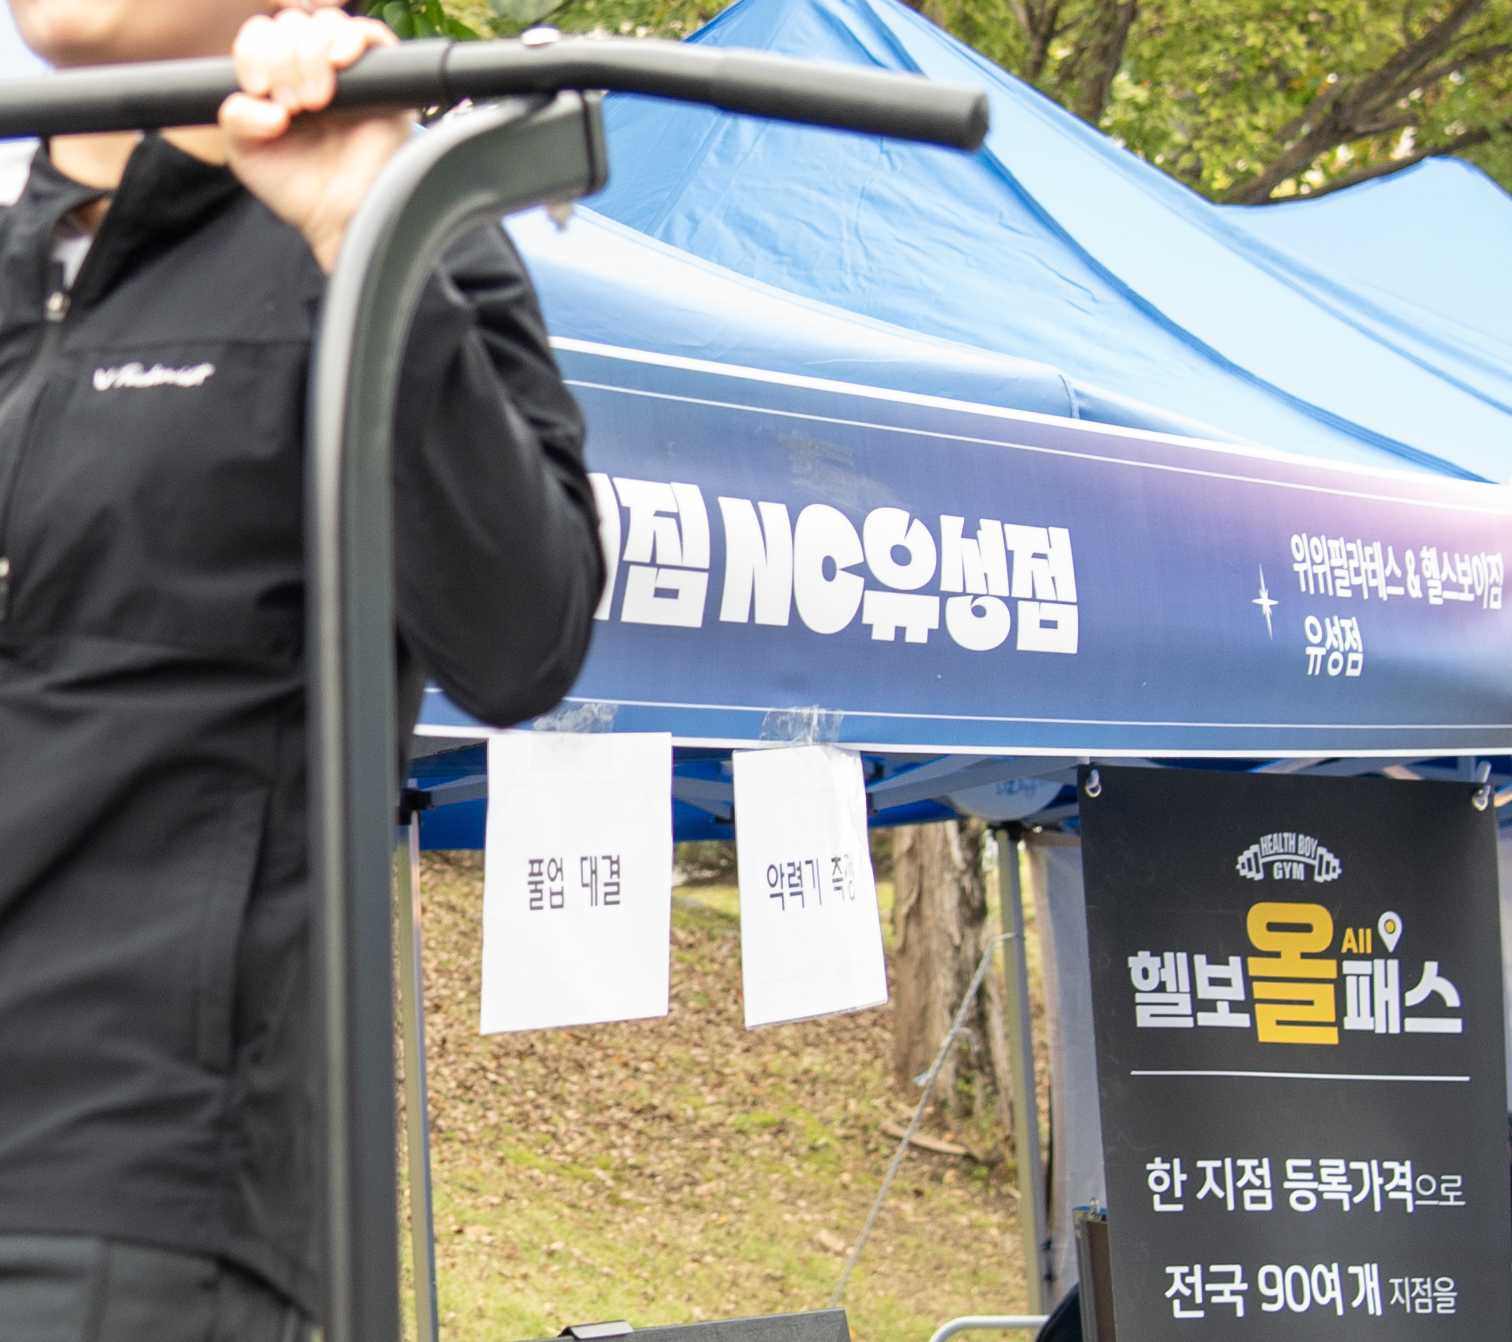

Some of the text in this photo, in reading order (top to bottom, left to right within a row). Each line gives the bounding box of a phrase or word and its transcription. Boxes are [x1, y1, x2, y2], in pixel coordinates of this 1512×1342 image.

[1290, 532, 1504, 610] 위위필라테스 & 헬스보이짐
[1304, 615, 1364, 677] 유성점
[1260, 832, 1318, 858] HEALTH BOY
[1273, 862, 1305, 881] GYM
[527, 854, 622, 911] 풀업 대결
[766, 858, 823, 911] 악력기
[1341, 927, 1372, 954] All
[1145, 1157, 1466, 1213] 한 지점 등록가격으로
[1164, 1264, 1248, 1319] 전국
[1388, 1276, 1458, 1314] 지점을
